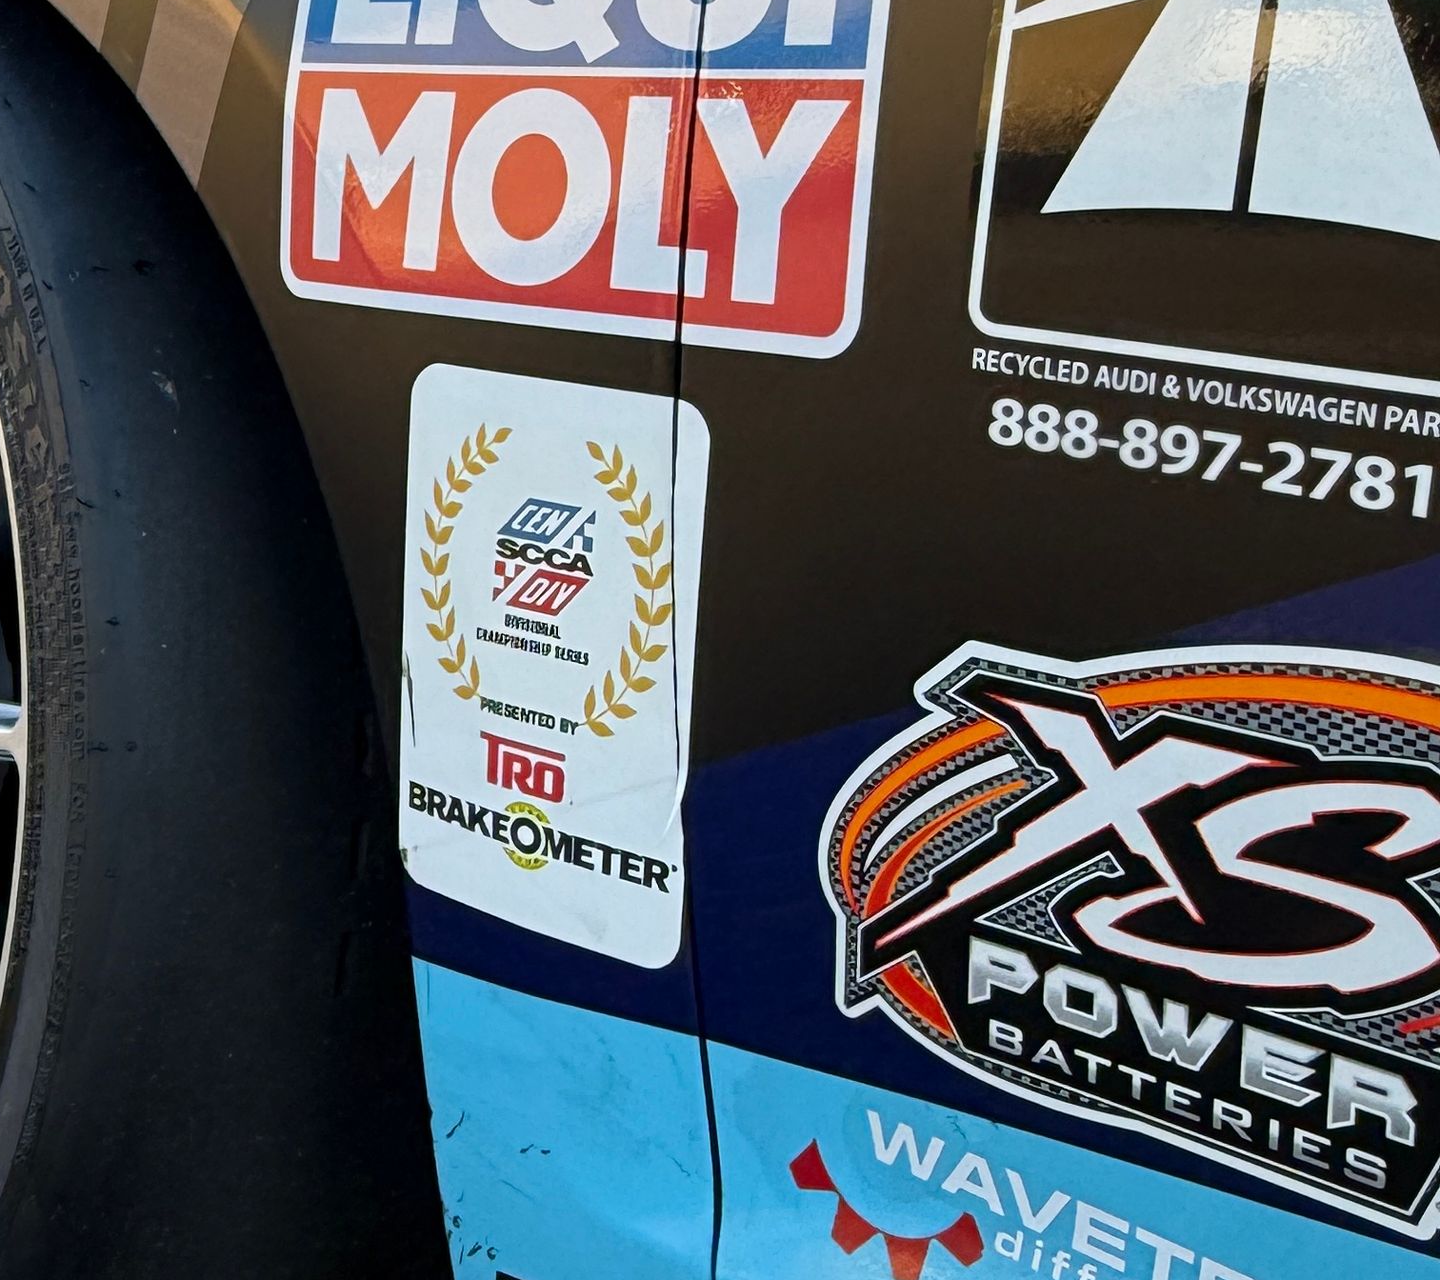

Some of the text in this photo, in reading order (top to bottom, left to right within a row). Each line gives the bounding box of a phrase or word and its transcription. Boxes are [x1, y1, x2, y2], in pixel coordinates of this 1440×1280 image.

[312, 87, 851, 304] MOLY
[971, 347, 1089, 385] RECYCLED
[1093, 365, 1156, 396] AUDI
[1161, 374, 1181, 400] &
[1186, 376, 1378, 429] VOLKSWAGEN
[987, 397, 1434, 519] 888-897-2781
[495, 537, 594, 577] SCCA
[510, 504, 571, 537] CEN
[518, 577, 577, 610] DIV
[480, 695, 578, 736] PRESENTED BY
[408, 779, 670, 894] BRAKEOMETER
[968, 935, 1420, 1147] POWER
[989, 1020, 1387, 1190] BATTERIES
